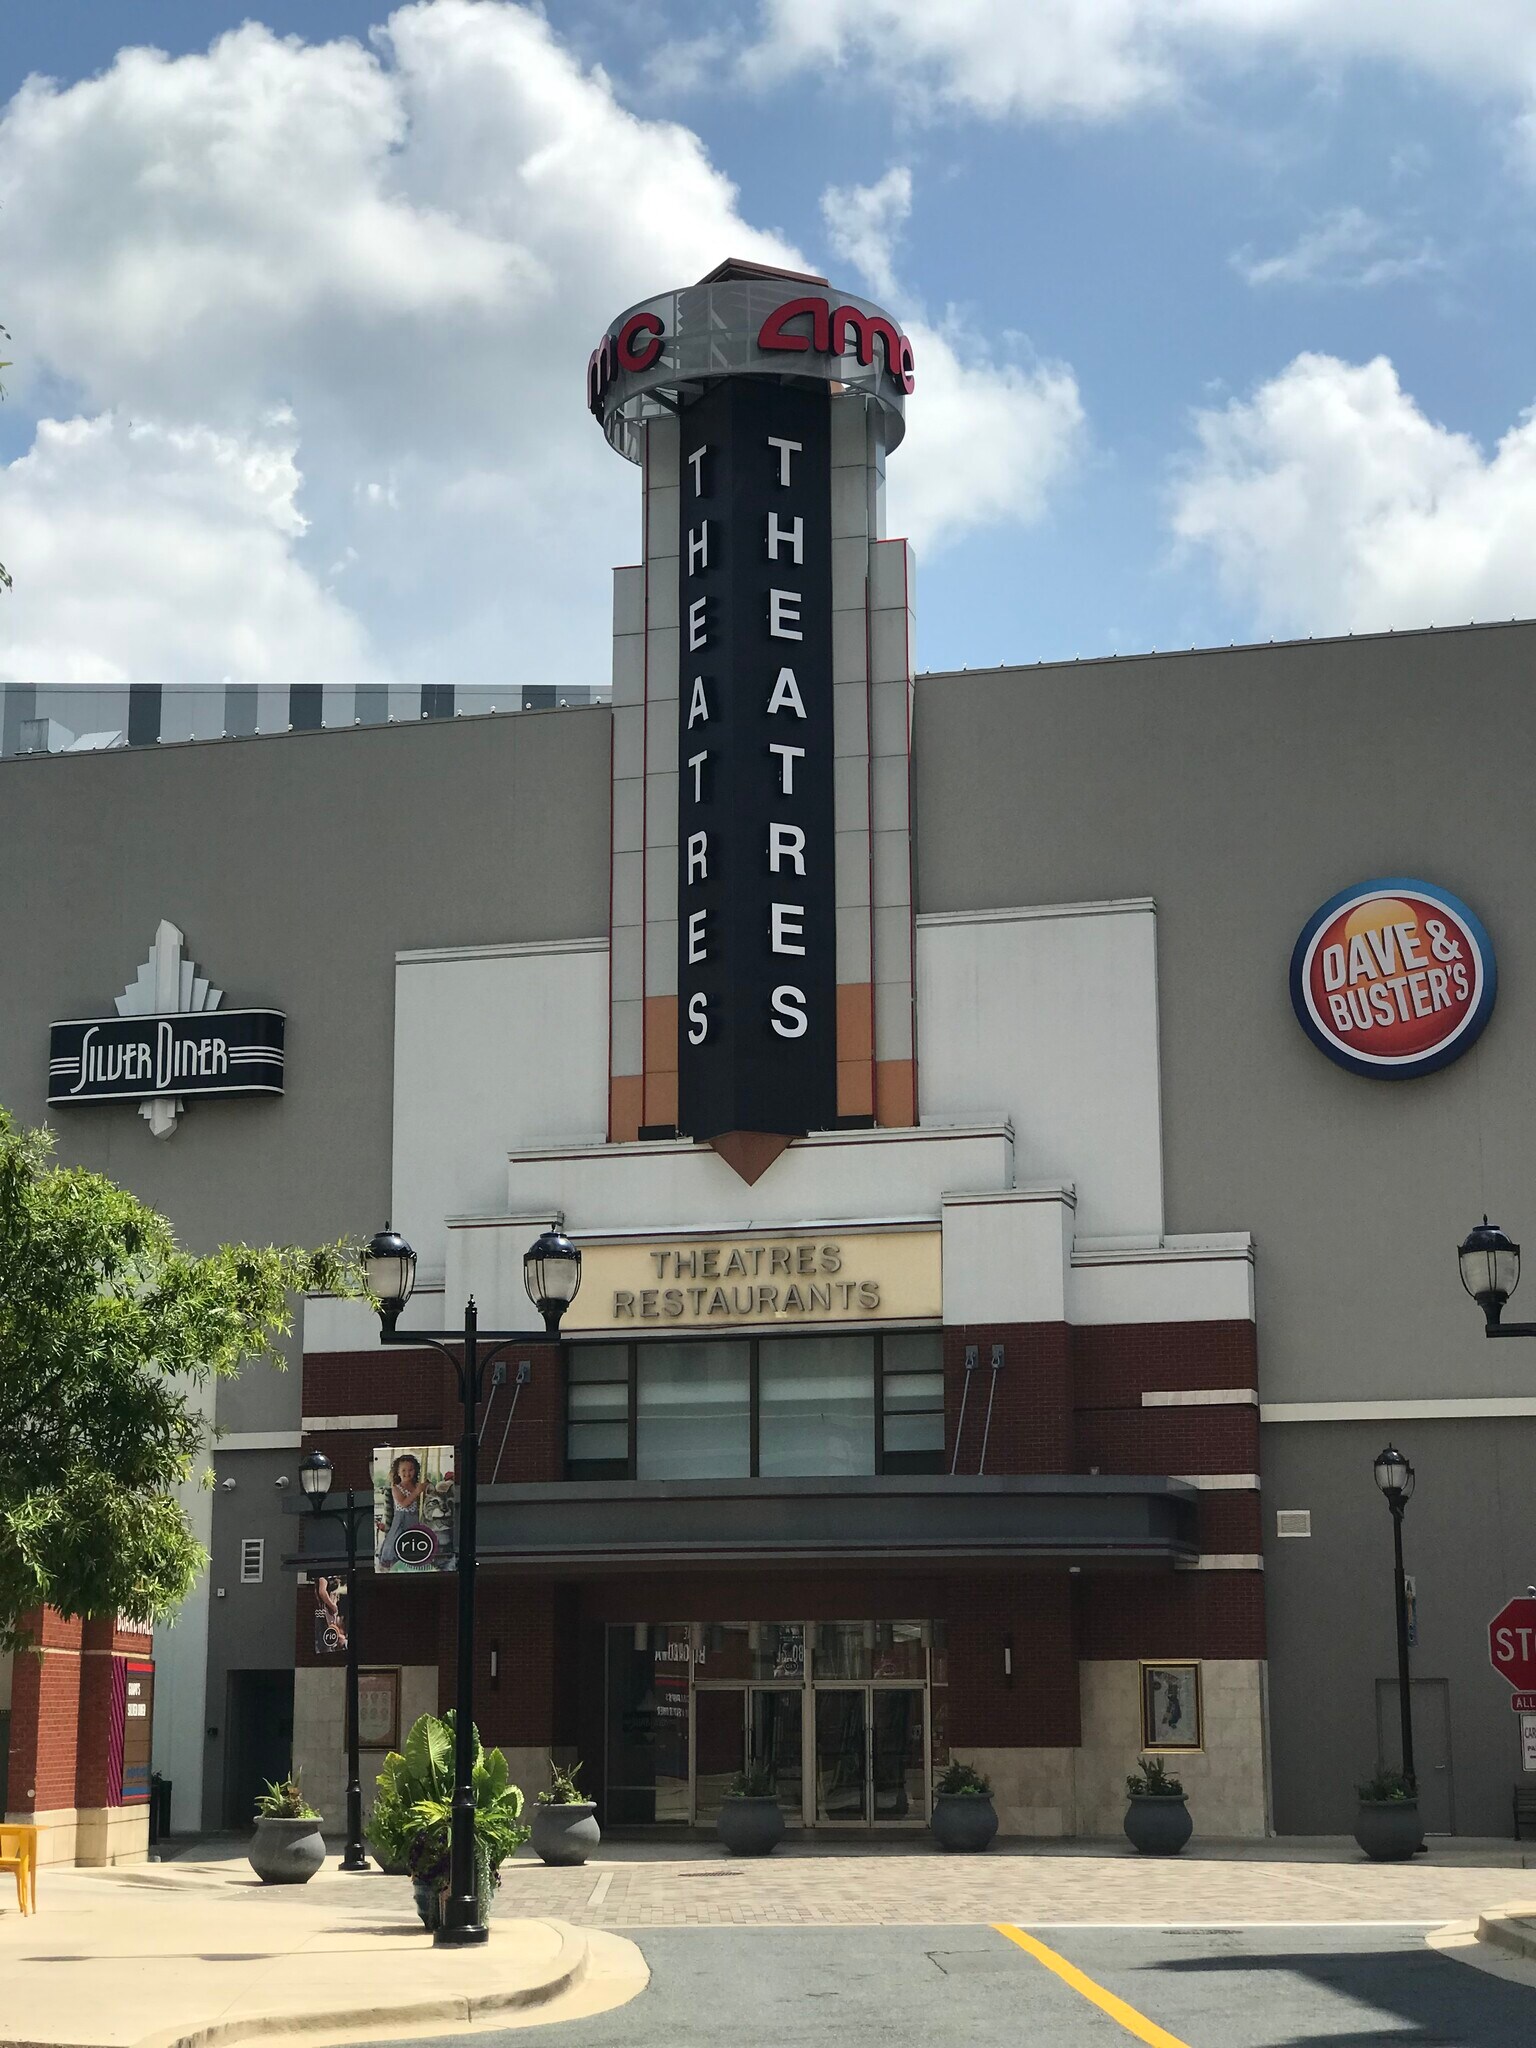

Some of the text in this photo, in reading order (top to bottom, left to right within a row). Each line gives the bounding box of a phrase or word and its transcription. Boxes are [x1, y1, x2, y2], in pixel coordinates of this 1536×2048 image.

[587, 312, 665, 411] mc
[758, 297, 915, 395] amc
[687, 444, 709, 1045] THEATRES
[767, 436, 808, 1038] THEATRES
[1322, 919, 1463, 992] DAVE &
[1327, 962, 1469, 1032] BUSTER'S
[69, 1021, 228, 1094] SILVER DINER
[650, 1243, 842, 1279] THEATRES
[612, 1280, 881, 1319] RESTAURANTS
[401, 1538, 428, 1552] rio
[325, 1631, 337, 1641] rio
[1496, 1627, 1536, 1662] ST
[1516, 1696, 1536, 1708] ALL
[1525, 1727, 1536, 1739] CAR
